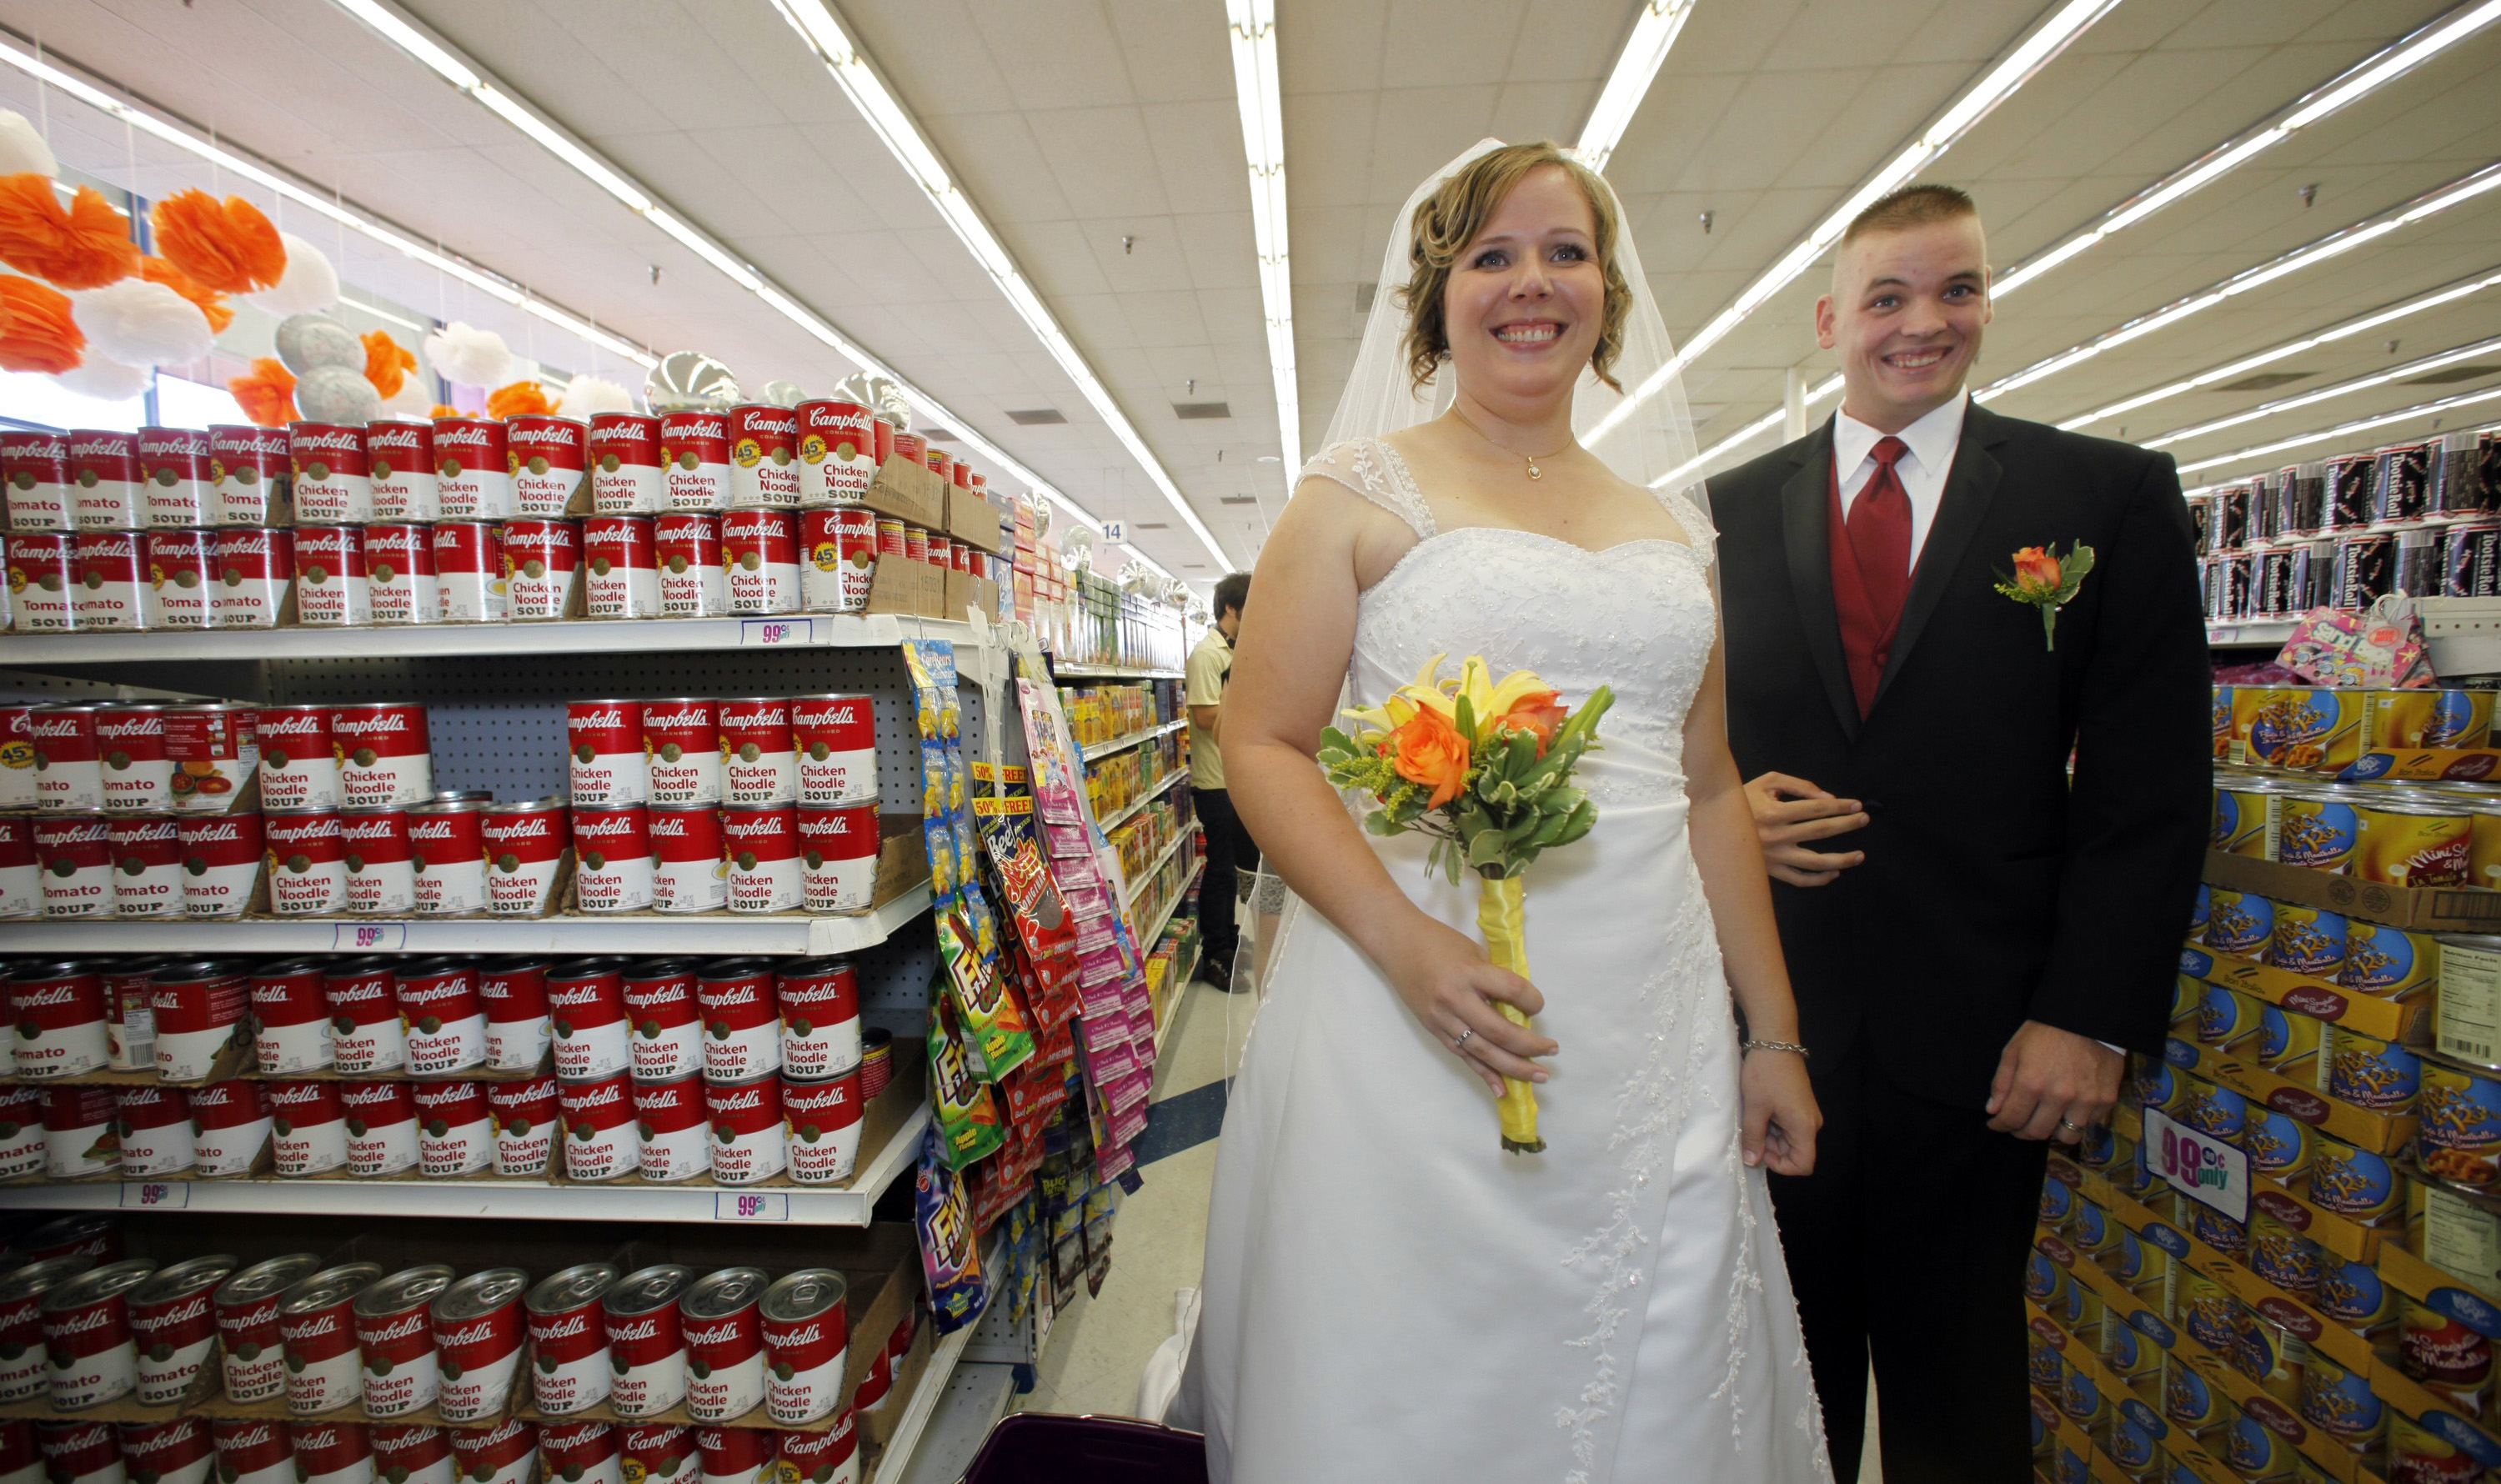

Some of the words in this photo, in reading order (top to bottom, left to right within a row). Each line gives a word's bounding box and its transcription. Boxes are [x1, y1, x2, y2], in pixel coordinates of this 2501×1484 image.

[810, 407, 872, 430] Campbell's
[508, 423, 574, 445] Campbell's
[662, 419, 724, 439] Campbell's
[211, 434, 288, 454] Campbell's
[824, 464, 868, 478] Chicken
[518, 479, 566, 490] Chicken
[595, 478, 636, 488] Chicken
[669, 475, 715, 485] Chicken
[825, 477, 868, 489] Noodle
[519, 491, 564, 502] Noodle
[597, 489, 635, 499] Noodle
[670, 487, 714, 496] Noodle
[828, 490, 865, 500] SOUP
[522, 504, 562, 512] SOUP
[598, 501, 634, 509] SOUP
[673, 499, 712, 507] SOUP
[13, 518, 55, 526] SOUP
[153, 514, 196, 524] SOUP
[723, 519, 784, 539] Campbell's
[1103, 524, 1120, 539] 14
[504, 527, 569, 548] Campbell's
[662, 579, 703, 588] Chicken
[731, 575, 776, 585] Chicken
[514, 583, 561, 594] Chicken
[733, 587, 775, 598] Noodle
[663, 590, 702, 600] Noodle
[664, 603, 700, 611] SOUP
[734, 600, 773, 609] SOUP
[644, 708, 708, 730] Campbell's
[720, 708, 784, 730] Campbell's
[793, 706, 855, 729] Campbell's
[333, 714, 405, 736] Campbell's
[343, 771, 396, 781] Chicken
[572, 768, 612, 778] Chicken
[652, 767, 698, 777] Chicken
[729, 767, 776, 777] Chicken
[801, 765, 845, 776] Chicken
[1004, 770, 1027, 782] REE!
[103, 780, 155, 790] Tomato
[572, 780, 611, 790] Noodle
[654, 779, 697, 790] Noodle
[730, 780, 775, 790] Noodle
[803, 778, 845, 788] Noodle
[345, 784, 395, 794] Noodle
[347, 795, 393, 805] SOUP
[574, 792, 609, 802] SOUP
[654, 791, 695, 801] SOUP
[733, 790, 773, 801] SOUP
[804, 791, 843, 800] SOUP
[106, 798, 148, 807] SOUP
[1005, 800, 1032, 812] FREE!
[267, 820, 341, 842] Campbell's
[277, 877, 331, 888] Chicken
[489, 877, 538, 888] Chicken
[730, 874, 772, 885] Chicken
[43, 885, 101, 898] Tomato
[114, 885, 169, 895] Tomato
[278, 889, 330, 900] Noodle
[491, 889, 537, 900] Noodle
[732, 886, 772, 897] Noodle
[48, 904, 95, 914] SOUP
[118, 902, 163, 913] SOUP
[281, 900, 328, 910] SOUP
[494, 900, 534, 911] SOUP
[734, 900, 769, 909] SOUP
[633, 1041, 679, 1054] Chicken
[785, 1040, 828, 1052] Chicken
[985, 1034, 1005, 1053] Apple
[634, 1054, 678, 1065] Noodle
[787, 1052, 827, 1063] Noodle
[637, 1065, 676, 1076] SOUP
[789, 1064, 825, 1075] SOUP
[782, 1088, 844, 1113] Campbell's
[1037, 1088, 1065, 1107] ORIGINAL
[955, 1128, 977, 1146] Apple
[568, 1143, 613, 1156] Chicken
[791, 1145, 836, 1156] Chicken
[569, 1153, 613, 1167] Noodle
[794, 1156, 835, 1168] Noodle
[2162, 1126, 2201, 1188] 99
[2198, 1168, 2228, 1190] only
[572, 1166, 610, 1178] SOUP
[795, 1168, 833, 1180] SOUP
[1042, 1176, 1065, 1189] BUG
[363, 1376, 413, 1391] Chicken
[364, 1388, 413, 1402] Noodle
[367, 1400, 410, 1414] SOUP
